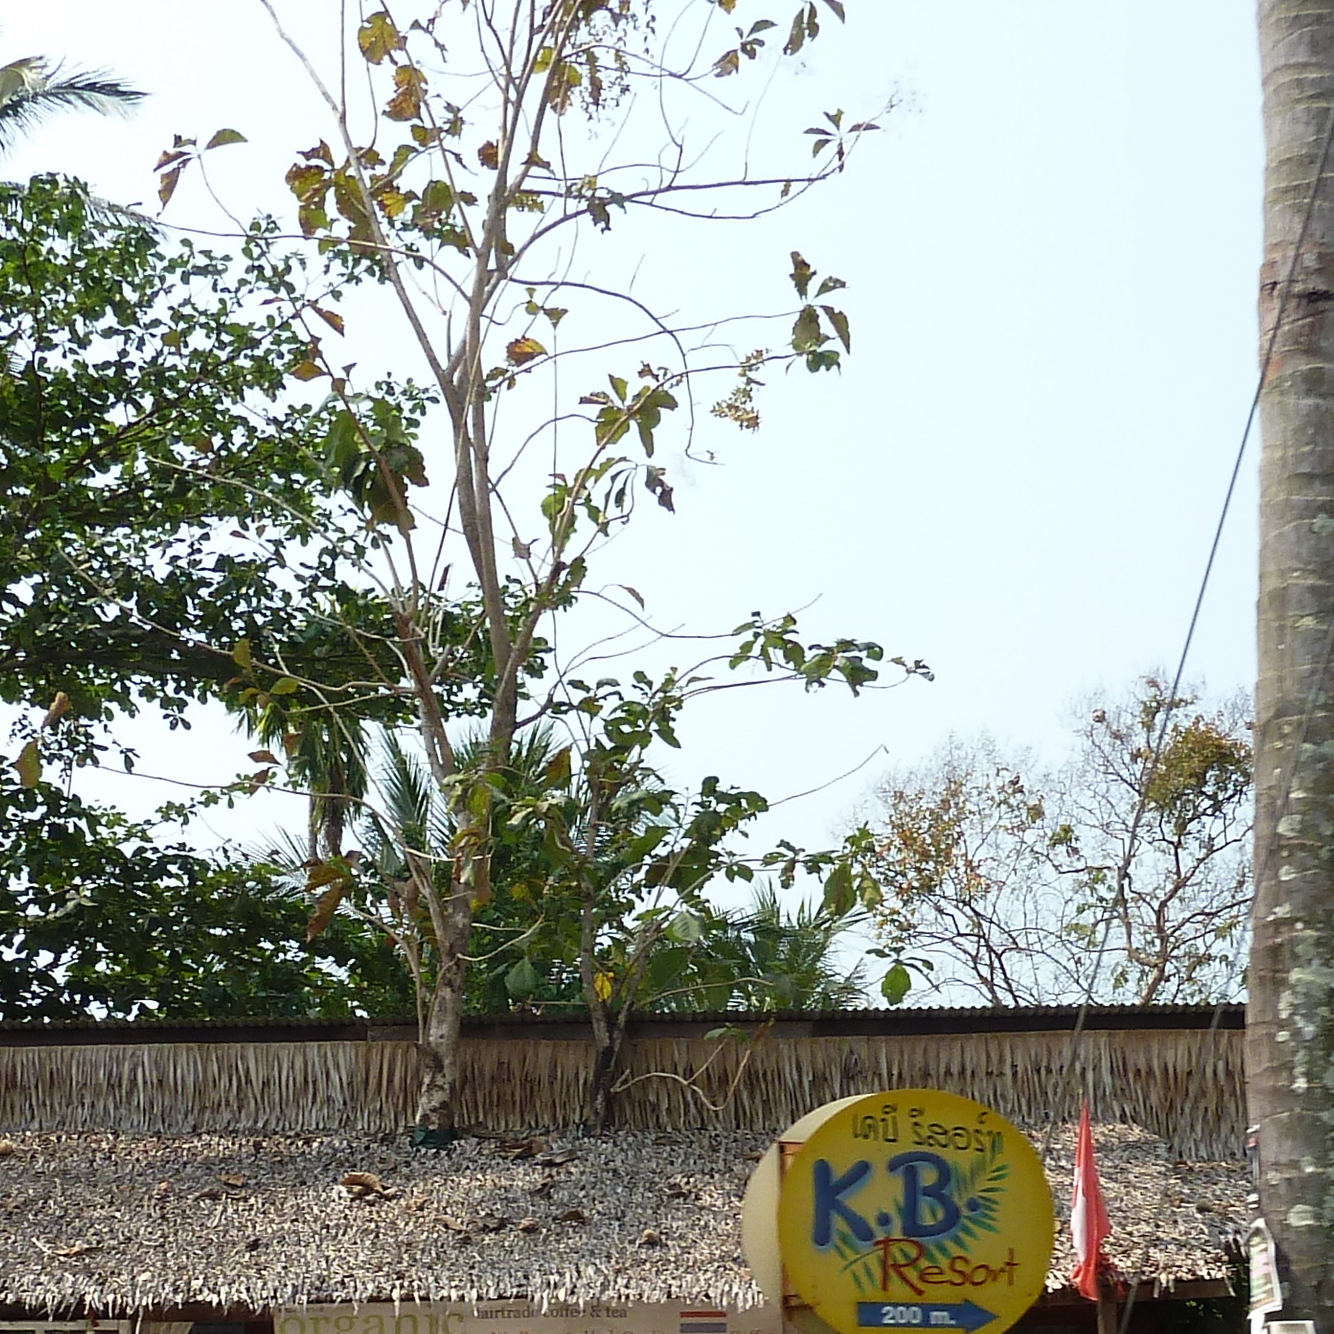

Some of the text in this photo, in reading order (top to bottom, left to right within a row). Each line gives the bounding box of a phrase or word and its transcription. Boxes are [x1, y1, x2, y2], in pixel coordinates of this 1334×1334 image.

[811, 1151, 981, 1247] K.B.
[871, 1236, 1021, 1297] Resort
[590, 1306, 602, 1319] &
[606, 1306, 628, 1319] tea
[880, 1306, 923, 1325] 200
